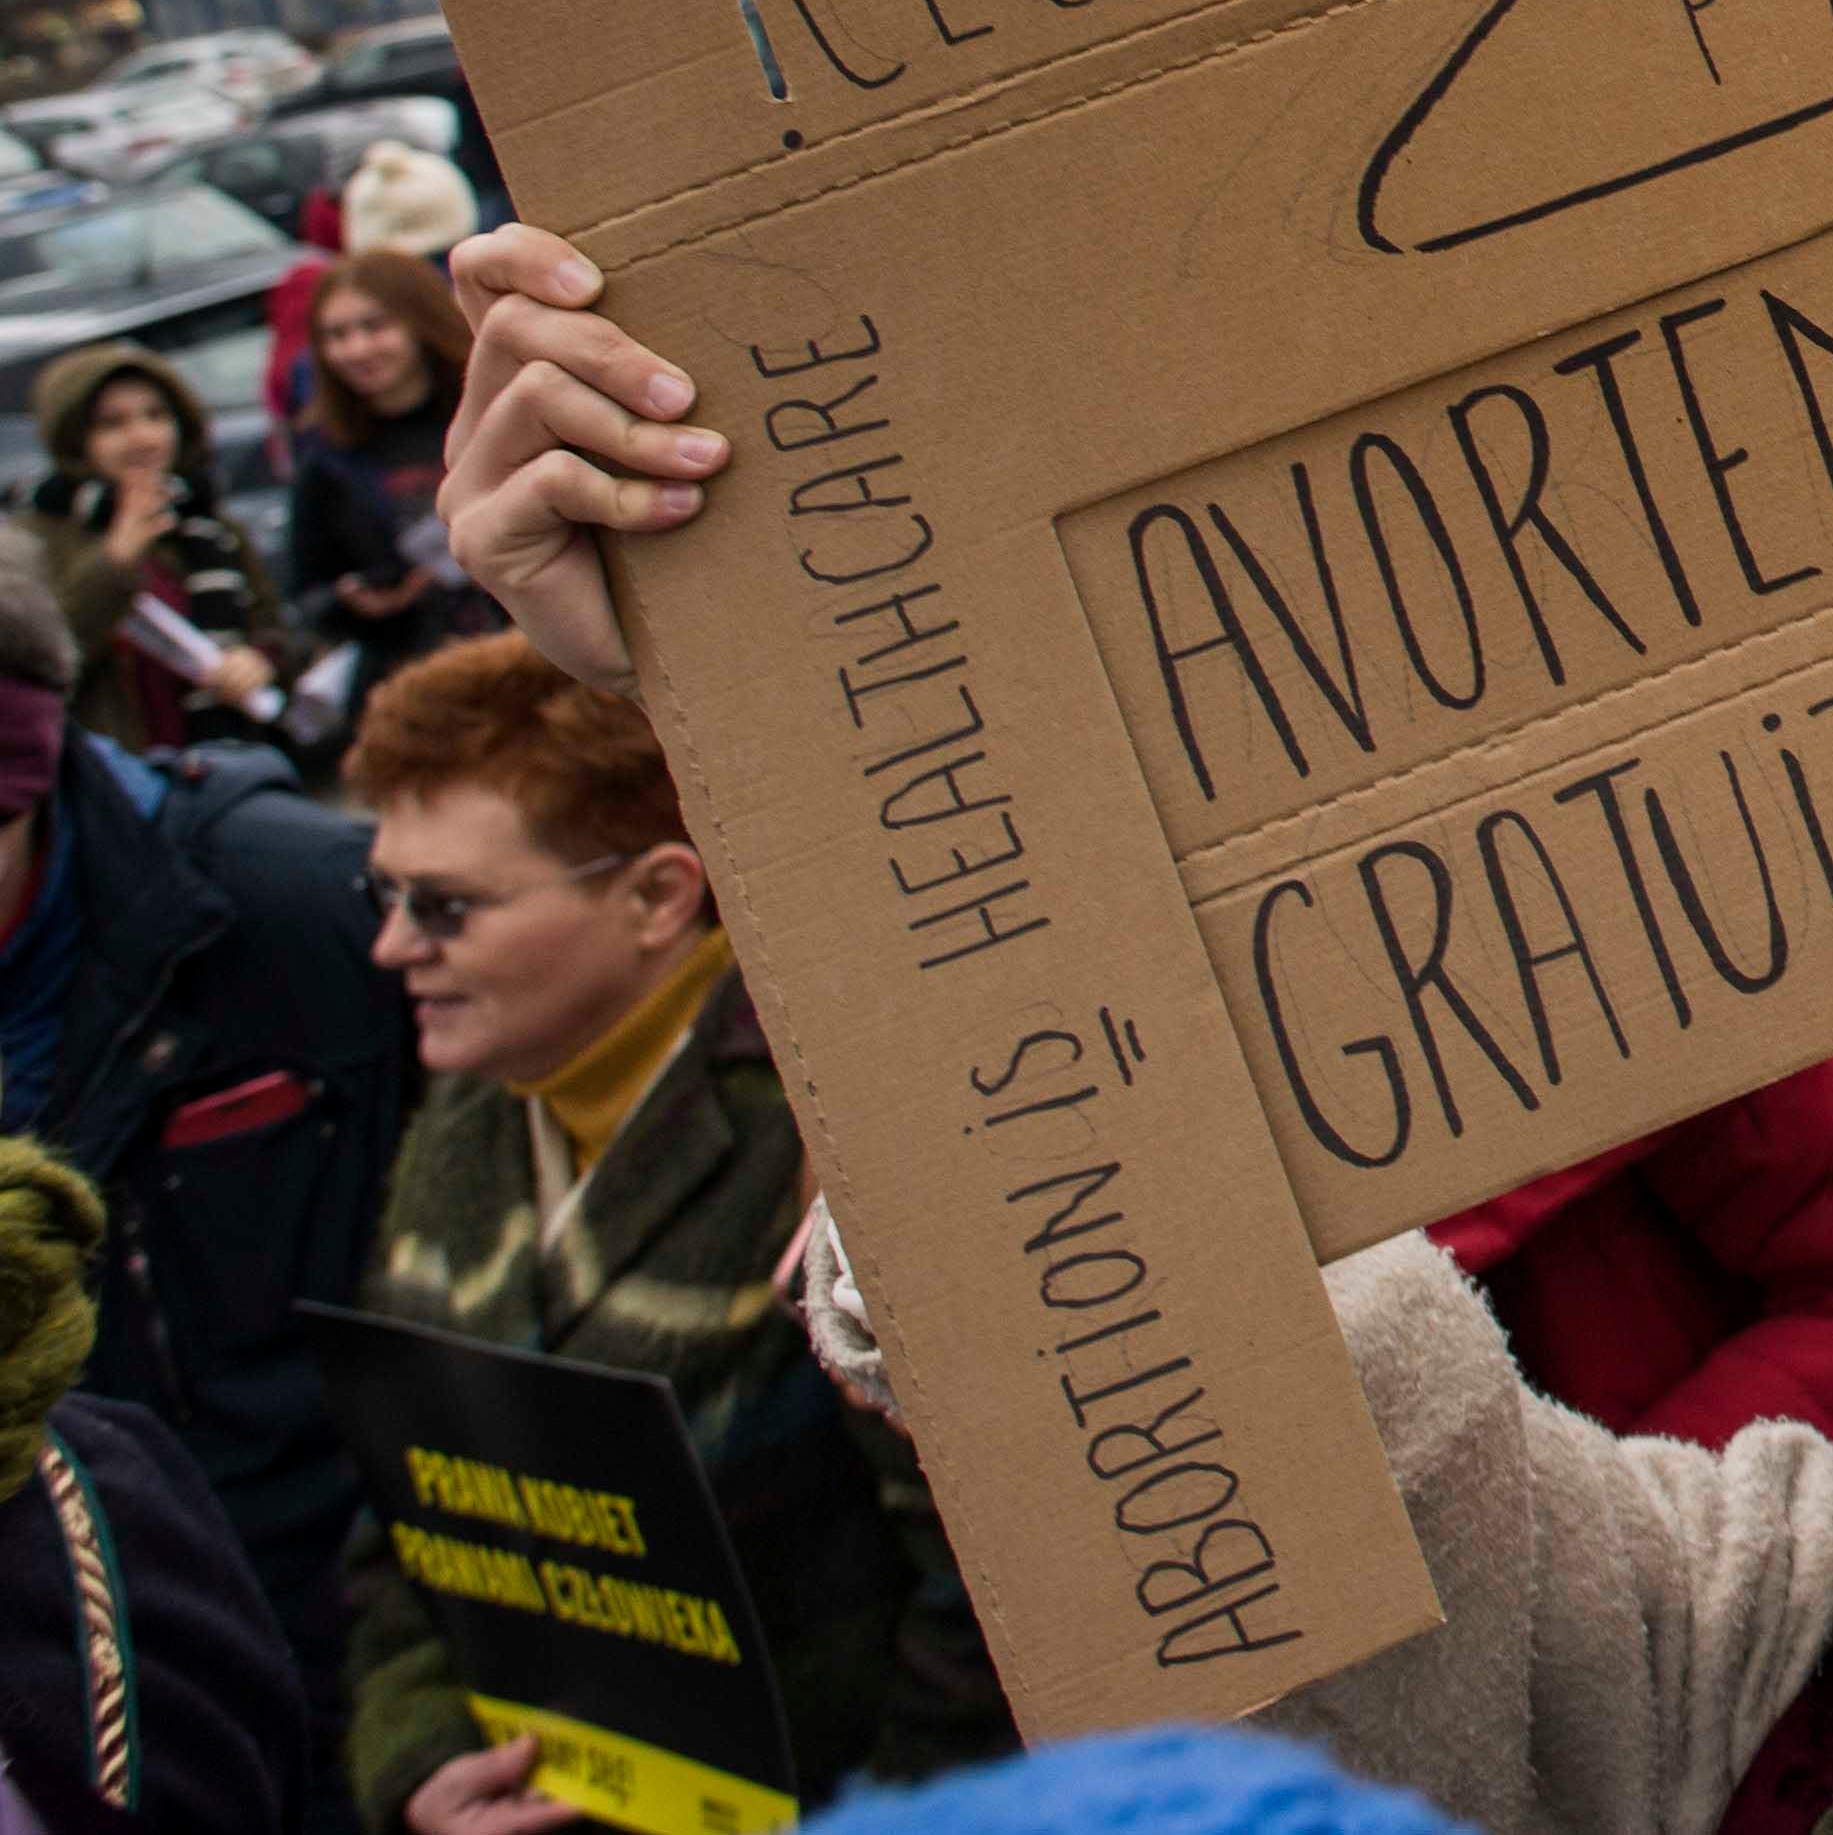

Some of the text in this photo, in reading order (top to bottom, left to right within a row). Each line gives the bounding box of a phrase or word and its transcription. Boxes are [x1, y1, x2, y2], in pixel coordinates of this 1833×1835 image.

[749, 313, 1304, 1668] ABORTION IS HEALTHCARE
[519, 1473, 648, 1558] KOBIET
[537, 1558, 742, 1666] CZŁOWIEKA
